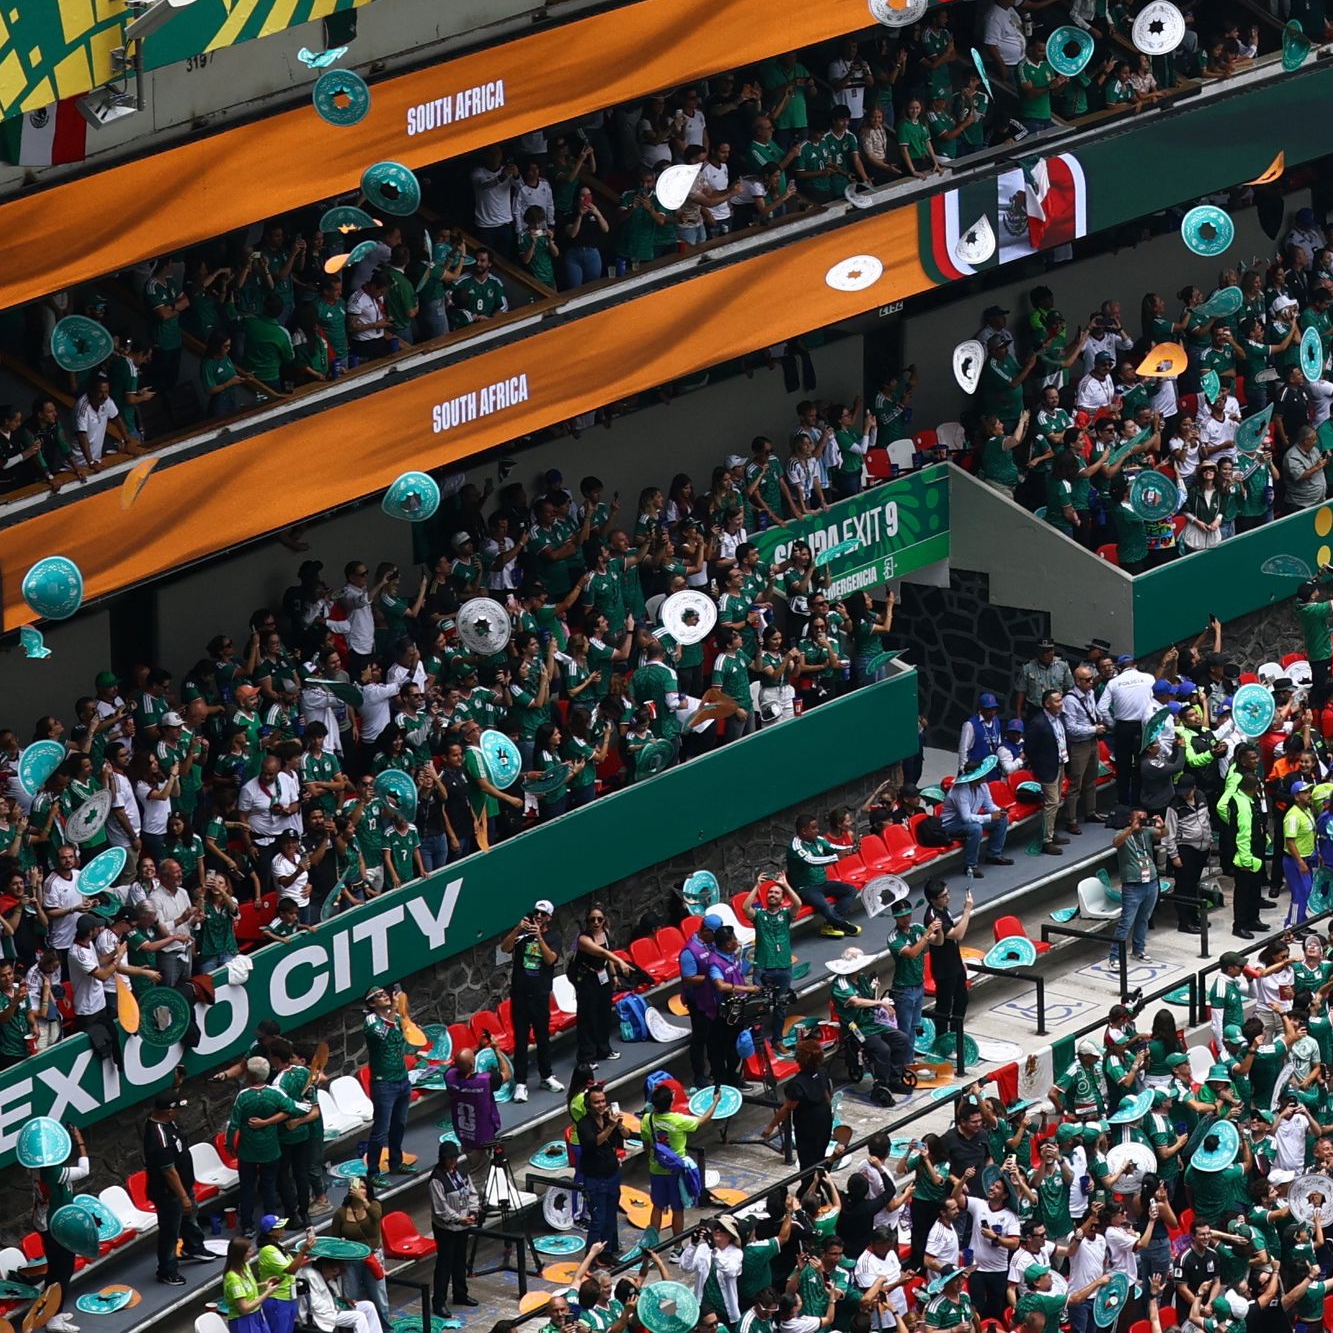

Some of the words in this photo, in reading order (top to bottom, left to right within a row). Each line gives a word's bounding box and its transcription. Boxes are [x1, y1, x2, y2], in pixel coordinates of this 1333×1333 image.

[407, 95, 452, 136] SOUTH
[454, 79, 505, 121] AFRICA
[432, 391, 477, 433] SOUTH
[479, 373, 529, 417] AFRICA
[842, 507, 882, 555] EXIT
[884, 500, 899, 537] 9
[269, 878, 464, 1017] CITY
